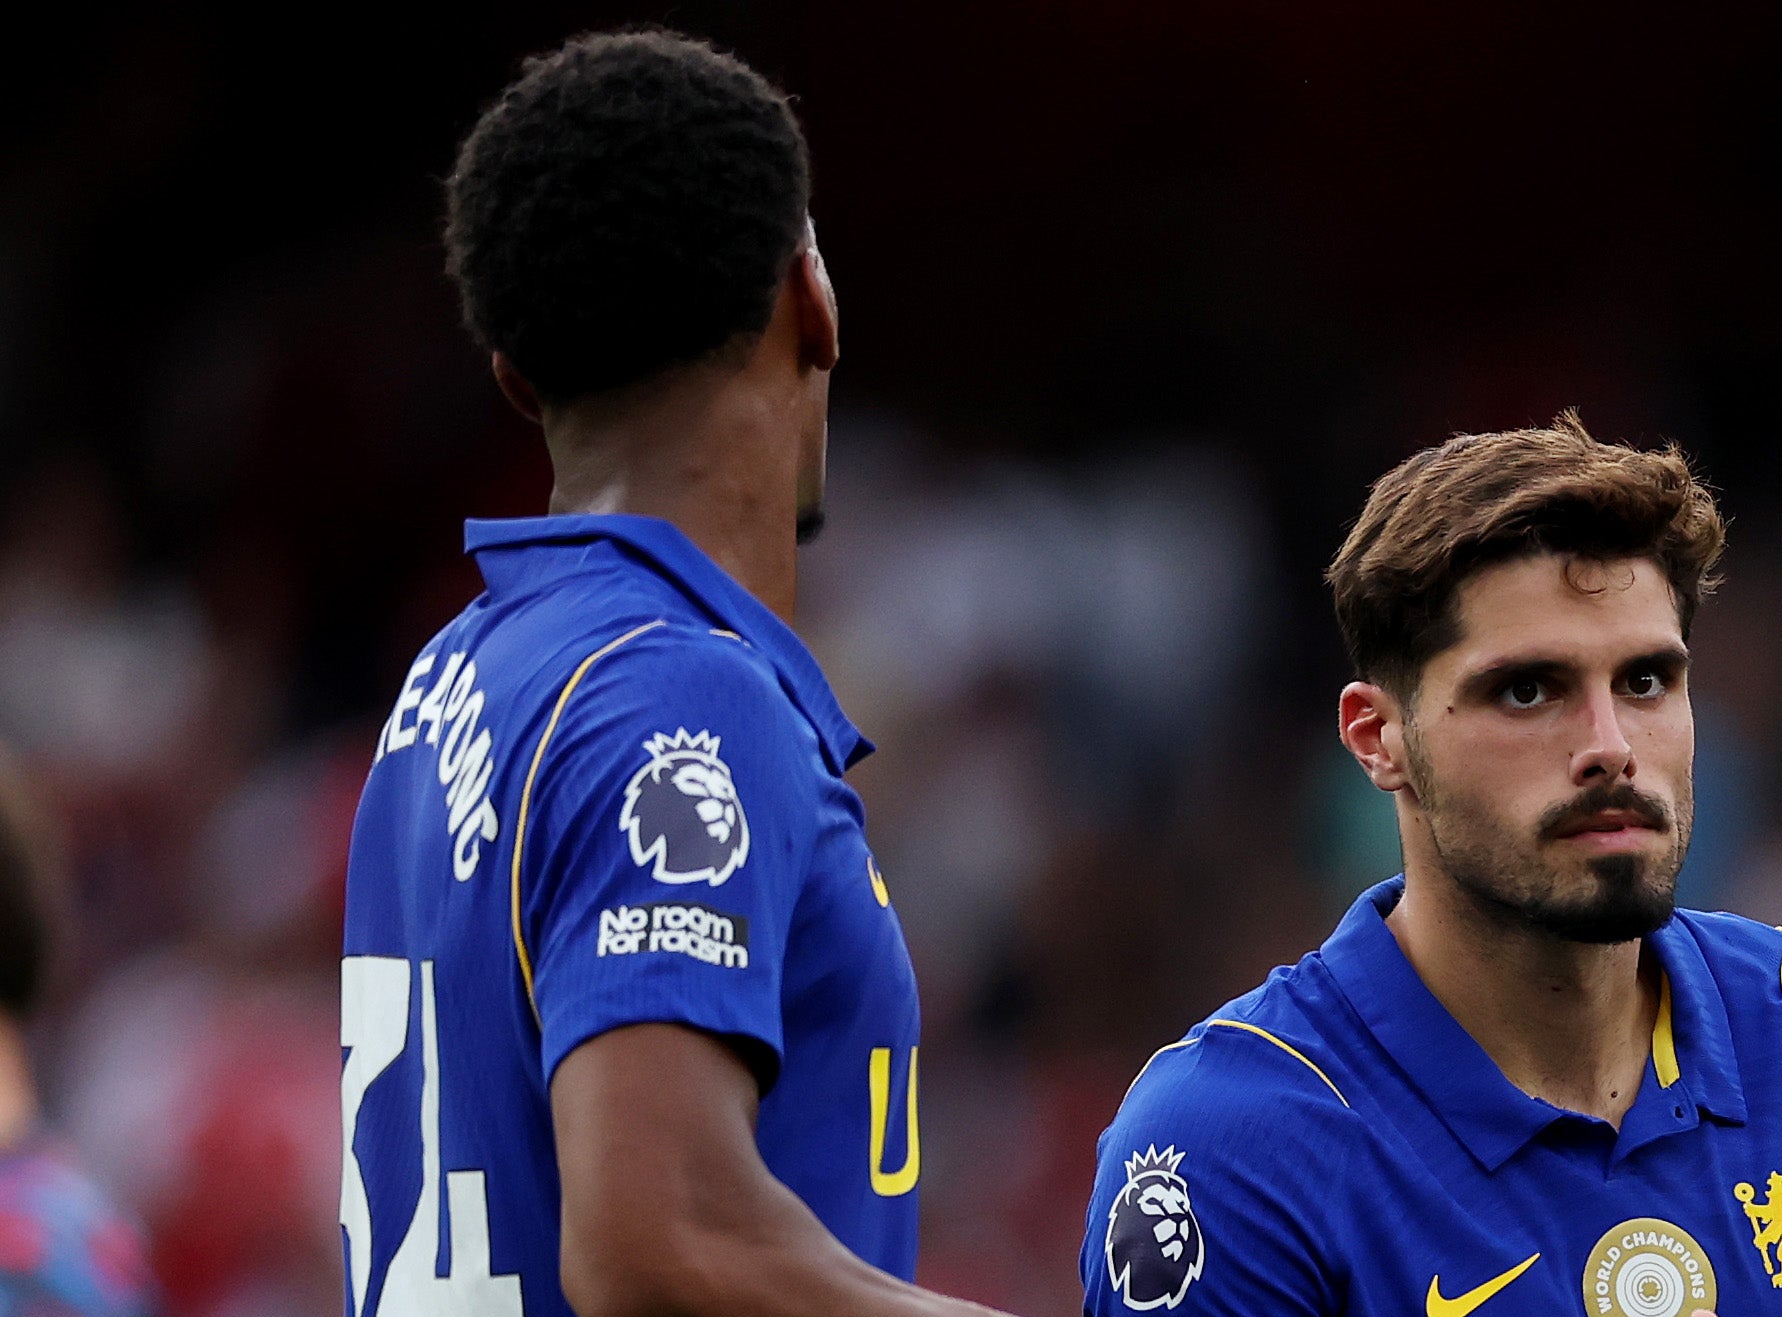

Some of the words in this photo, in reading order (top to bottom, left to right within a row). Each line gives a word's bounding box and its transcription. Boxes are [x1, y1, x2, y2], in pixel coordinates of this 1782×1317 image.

[600, 905, 649, 934] No
[652, 905, 734, 943] room
[597, 930, 647, 958] for
[649, 929, 749, 969] racism
[1596, 1246, 1622, 1315] WORLD
[1622, 1231, 1706, 1300] CHAMPIONS
